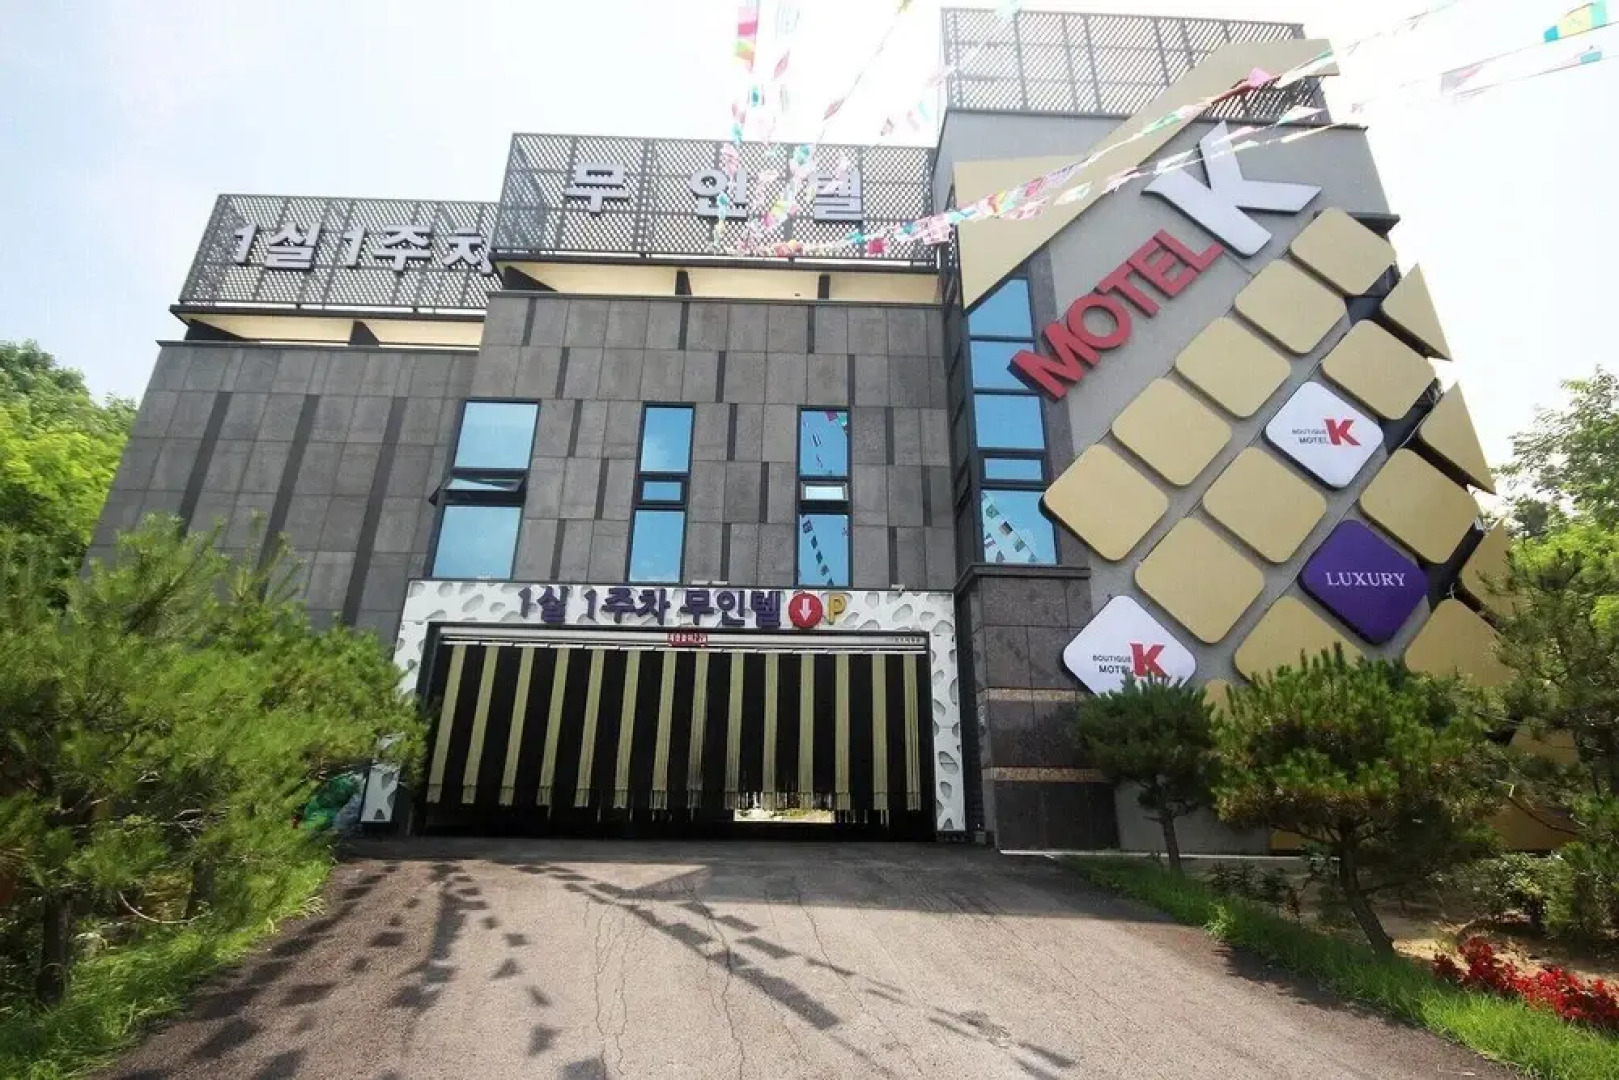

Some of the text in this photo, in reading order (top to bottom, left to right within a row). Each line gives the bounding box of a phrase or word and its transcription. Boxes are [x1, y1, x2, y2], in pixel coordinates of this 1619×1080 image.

[1008, 120, 1322, 400] MOTEL K
[1324, 419, 1361, 446] K
[1325, 572, 1406, 587] LUXURY
[518, 585, 848, 629] 1실 1주차 무인텔 P
[1092, 655, 1131, 663] BOUTIQUE
[1129, 643, 1167, 678] K
